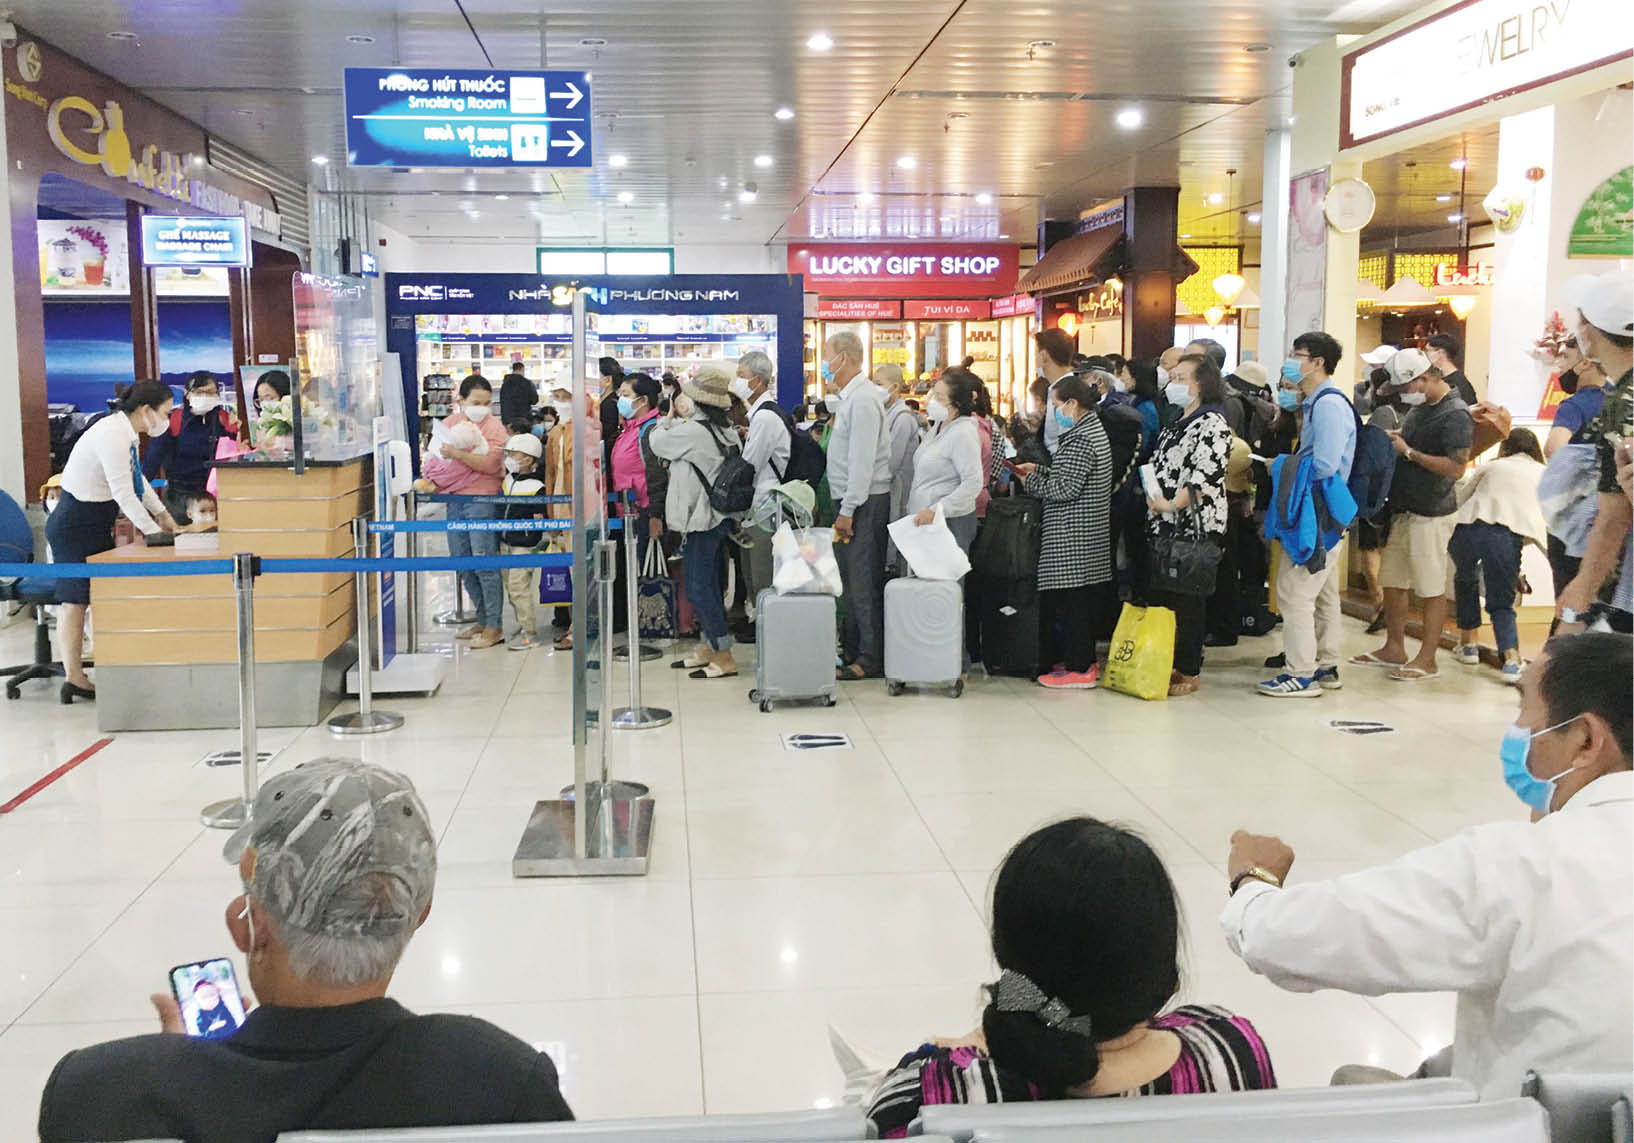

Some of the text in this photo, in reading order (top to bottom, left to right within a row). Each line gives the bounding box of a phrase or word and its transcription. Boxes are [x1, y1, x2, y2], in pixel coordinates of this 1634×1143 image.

[432, 75, 457, 92] HÚT
[408, 95, 507, 112] Smoking Room
[468, 144, 508, 158] Toilets
[182, 230, 230, 241] MASSAGE
[810, 256, 1000, 275] LUCKY GIFT SHOP
[399, 285, 443, 297] PNC
[508, 283, 551, 301] NHÀ
[695, 290, 739, 301] NAM
